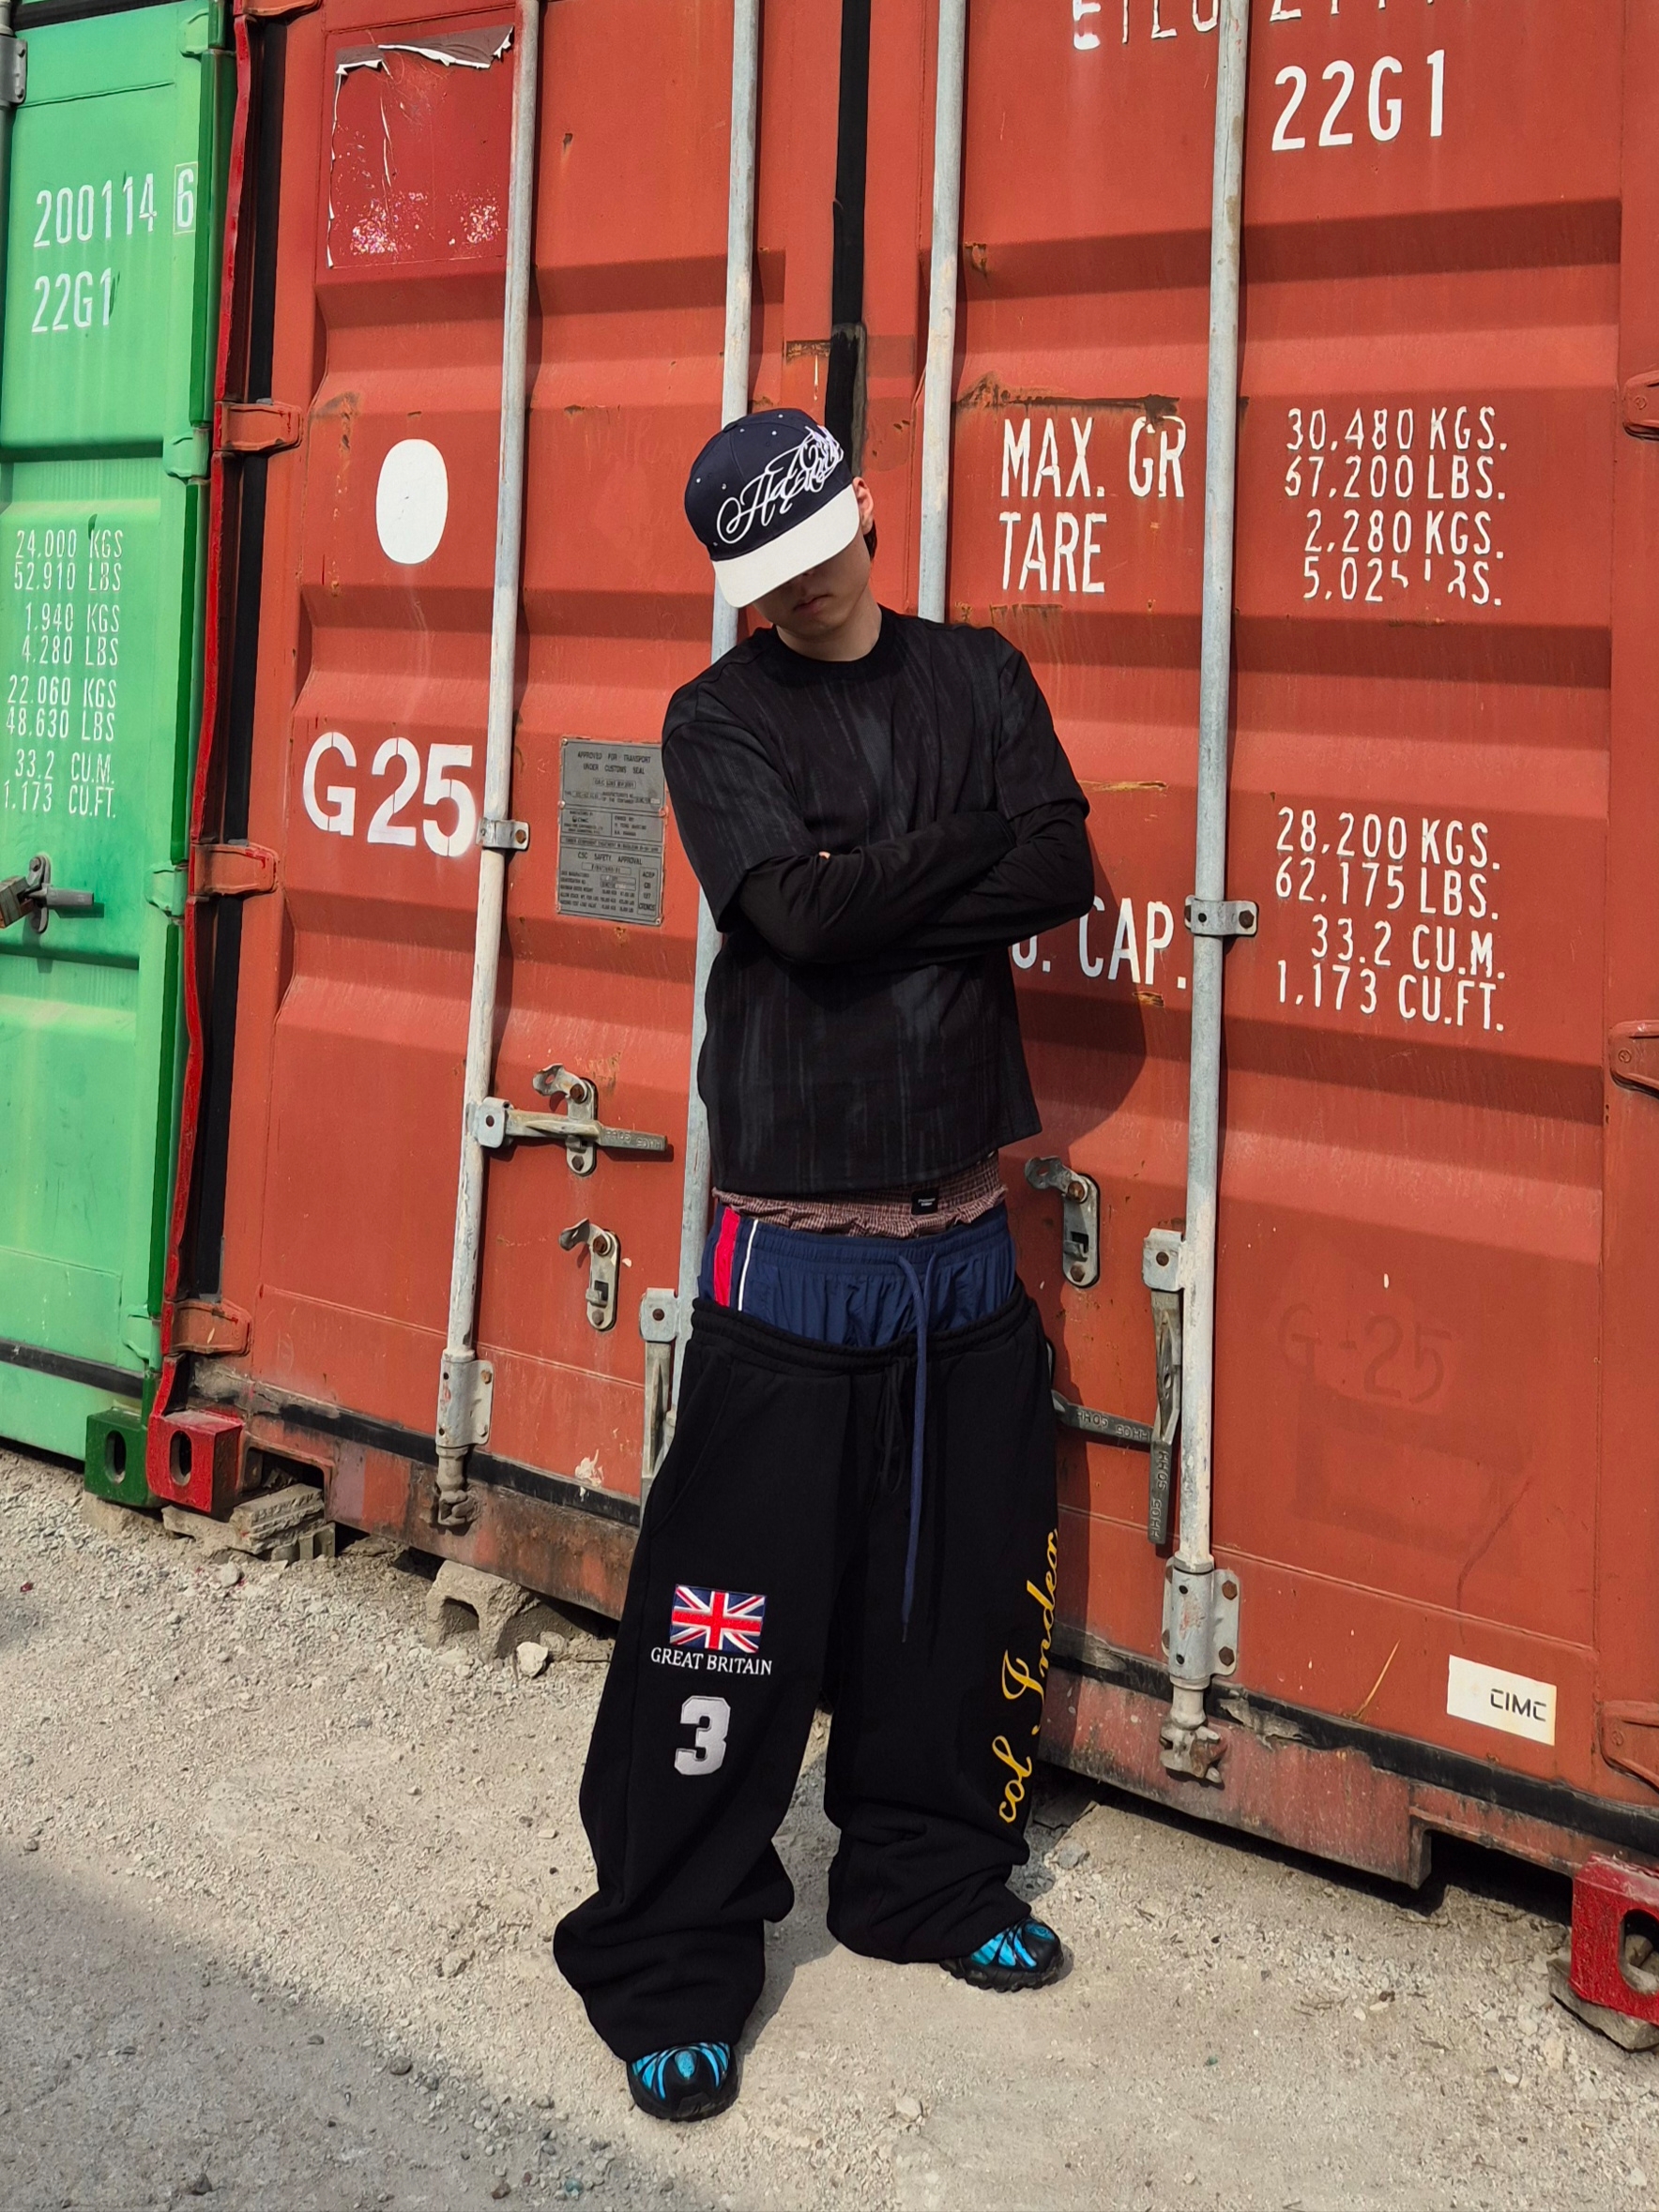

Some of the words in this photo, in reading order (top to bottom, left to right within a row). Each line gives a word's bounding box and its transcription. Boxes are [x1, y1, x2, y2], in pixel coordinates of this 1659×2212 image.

[1271, 49, 1445, 151] 22G1
[34, 173, 158, 248] 200114
[176, 168, 194, 228] 6
[31, 267, 112, 333] 22G1
[1429, 406, 1507, 451] KGS.
[1000, 417, 1104, 497] MAX.
[1129, 416, 1186, 498] GR
[1427, 455, 1506, 500] LBS.
[89, 529, 123, 559] KGS
[999, 511, 1107, 593] TARE
[1424, 509, 1504, 559] KGS.
[87, 562, 122, 592] LBS
[86, 603, 120, 633] KGS
[85, 635, 118, 666] LBS
[83, 677, 117, 709] KGS
[82, 709, 115, 742] LBS
[15, 749, 54, 780] 33.2
[302, 731, 477, 857] G25
[1421, 817, 1500, 871] KGS.
[1420, 866, 1499, 920] LBS.
[1079, 895, 1186, 990] CAP.
[1311, 913, 1392, 966] 33.2
[1412, 923, 1505, 979] CU.M.
[1398, 974, 1504, 1032] CU.FT.
[650, 1646, 704, 1670] GREAT
[706, 1654, 772, 1675] BRITAIN
[1490, 1689, 1546, 1722] CIMC
[674, 1694, 731, 1776] 3
